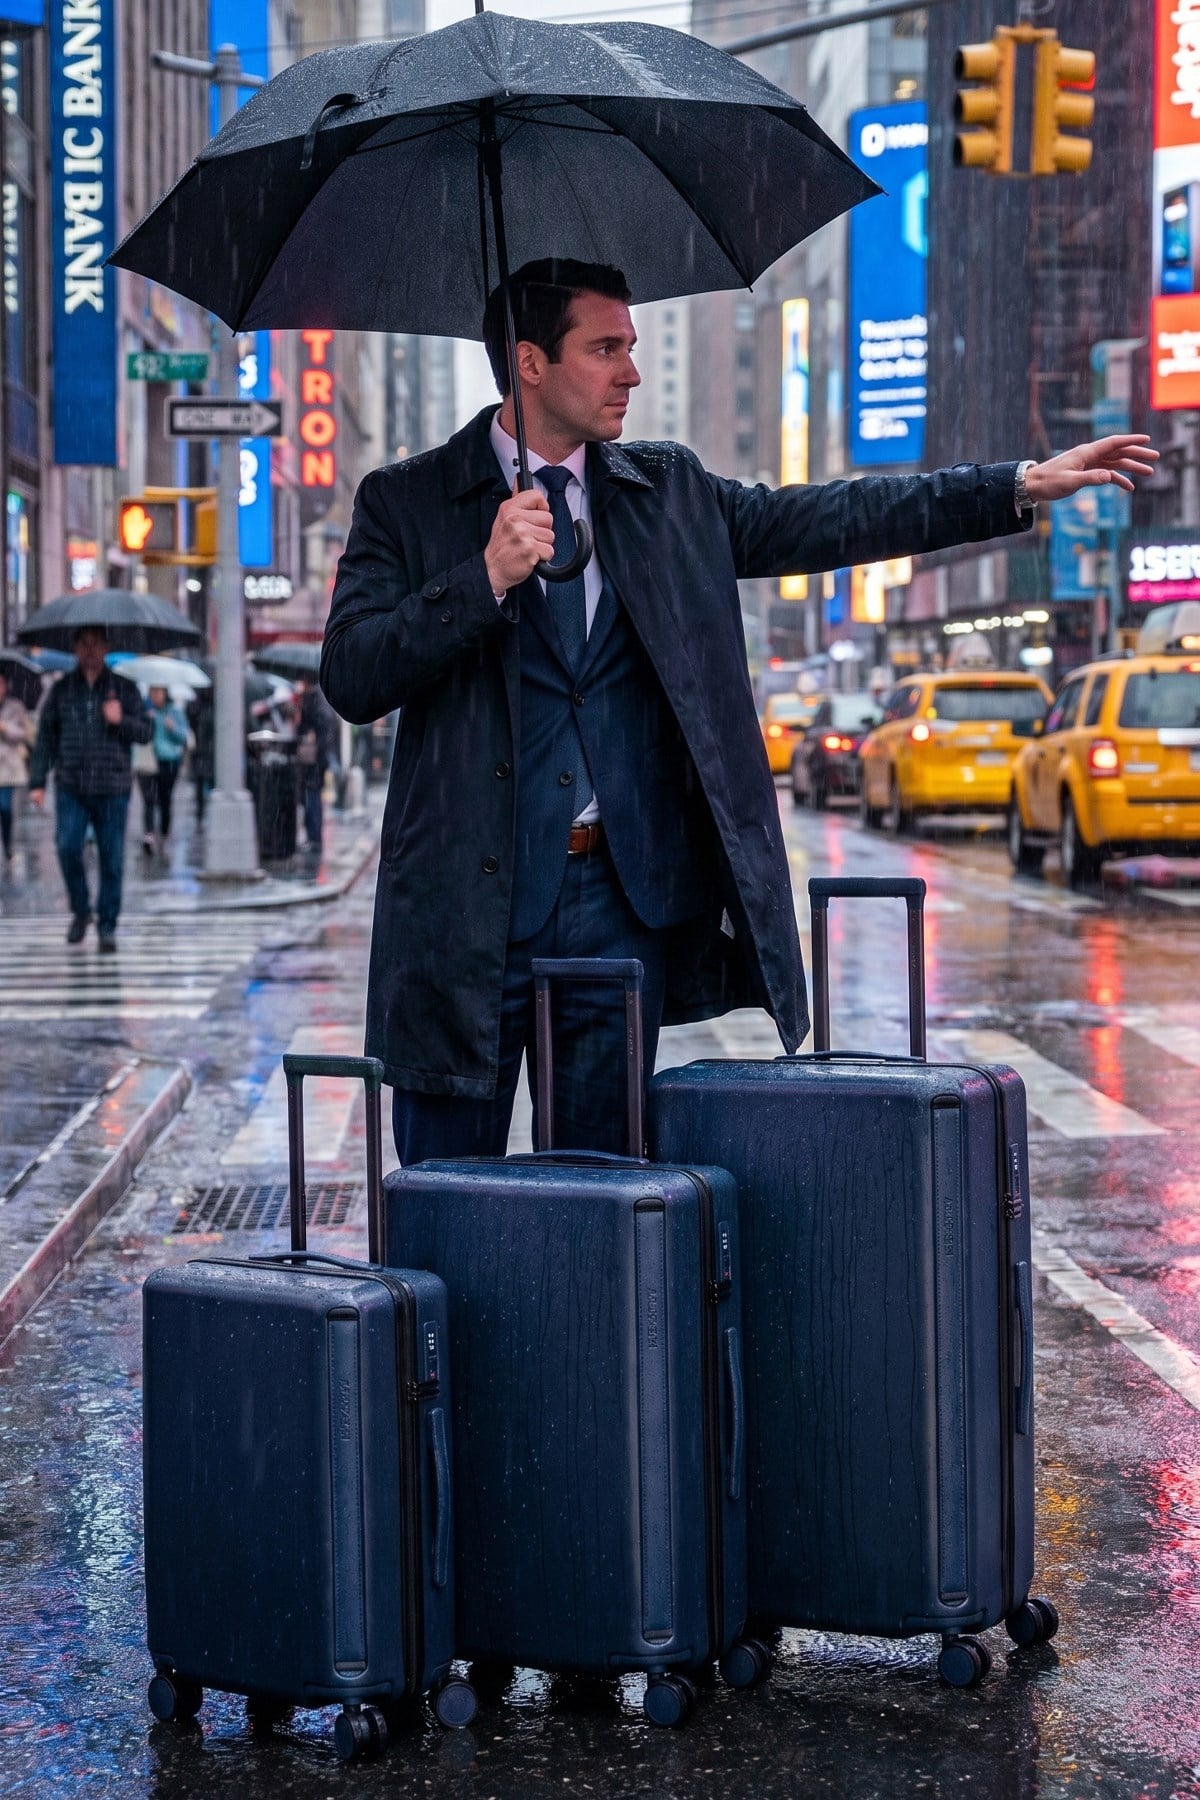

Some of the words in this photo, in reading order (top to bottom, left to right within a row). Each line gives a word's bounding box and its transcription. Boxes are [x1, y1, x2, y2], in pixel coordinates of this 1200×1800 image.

[62, 0, 104, 119] BANK
[63, 180, 104, 315] BANK
[184, 410, 213, 425] ONE
[232, 411, 263, 425] WAY
